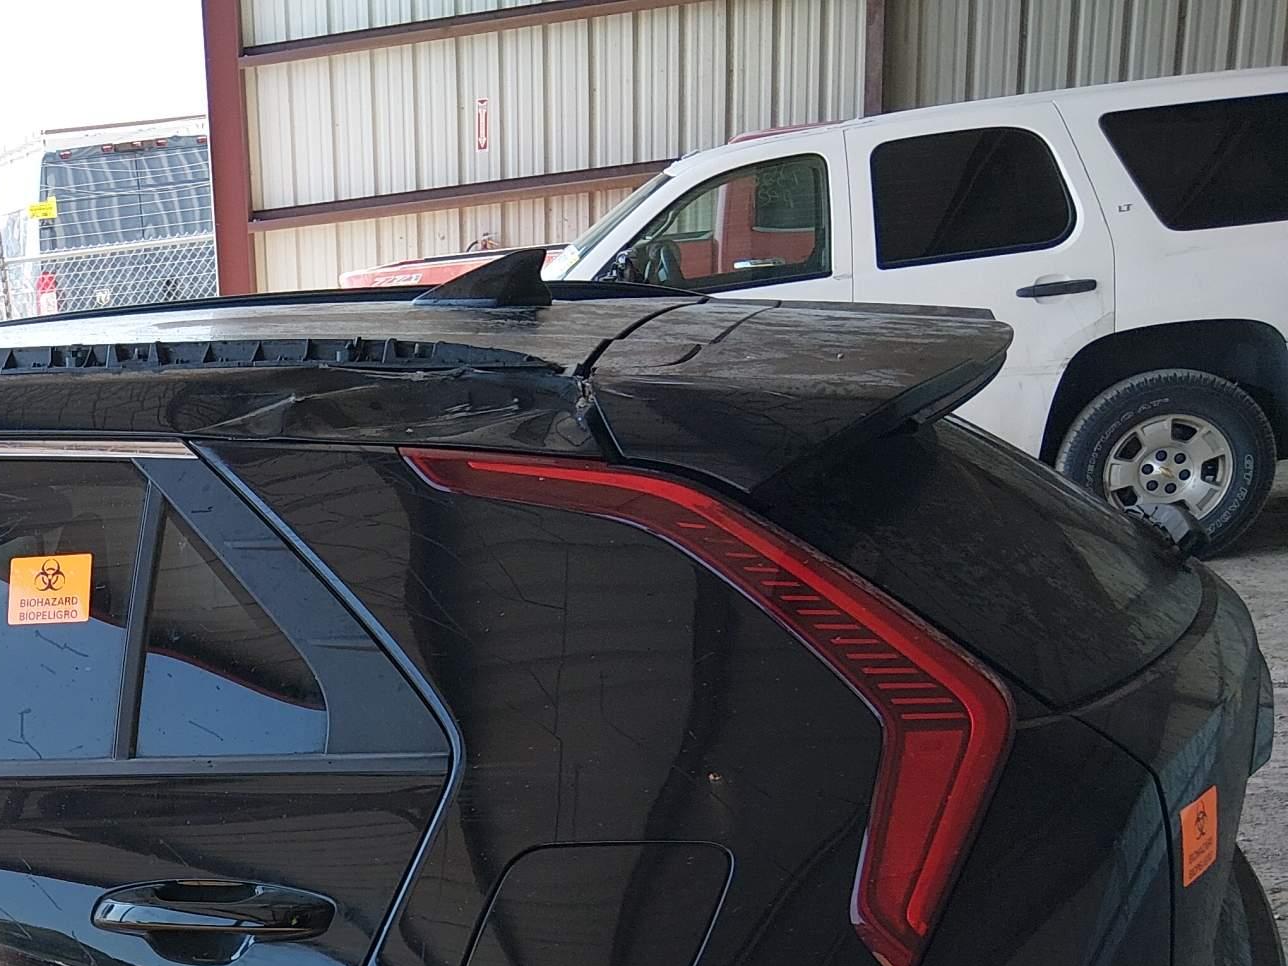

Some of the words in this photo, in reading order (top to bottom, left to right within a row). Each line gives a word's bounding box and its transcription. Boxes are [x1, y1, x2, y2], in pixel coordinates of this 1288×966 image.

[1117, 203, 1133, 212] LT
[1208, 487, 1248, 536] RADIA
[19, 597, 78, 608] BIOHAZARD
[19, 609, 78, 621] BIOPELIGRO
